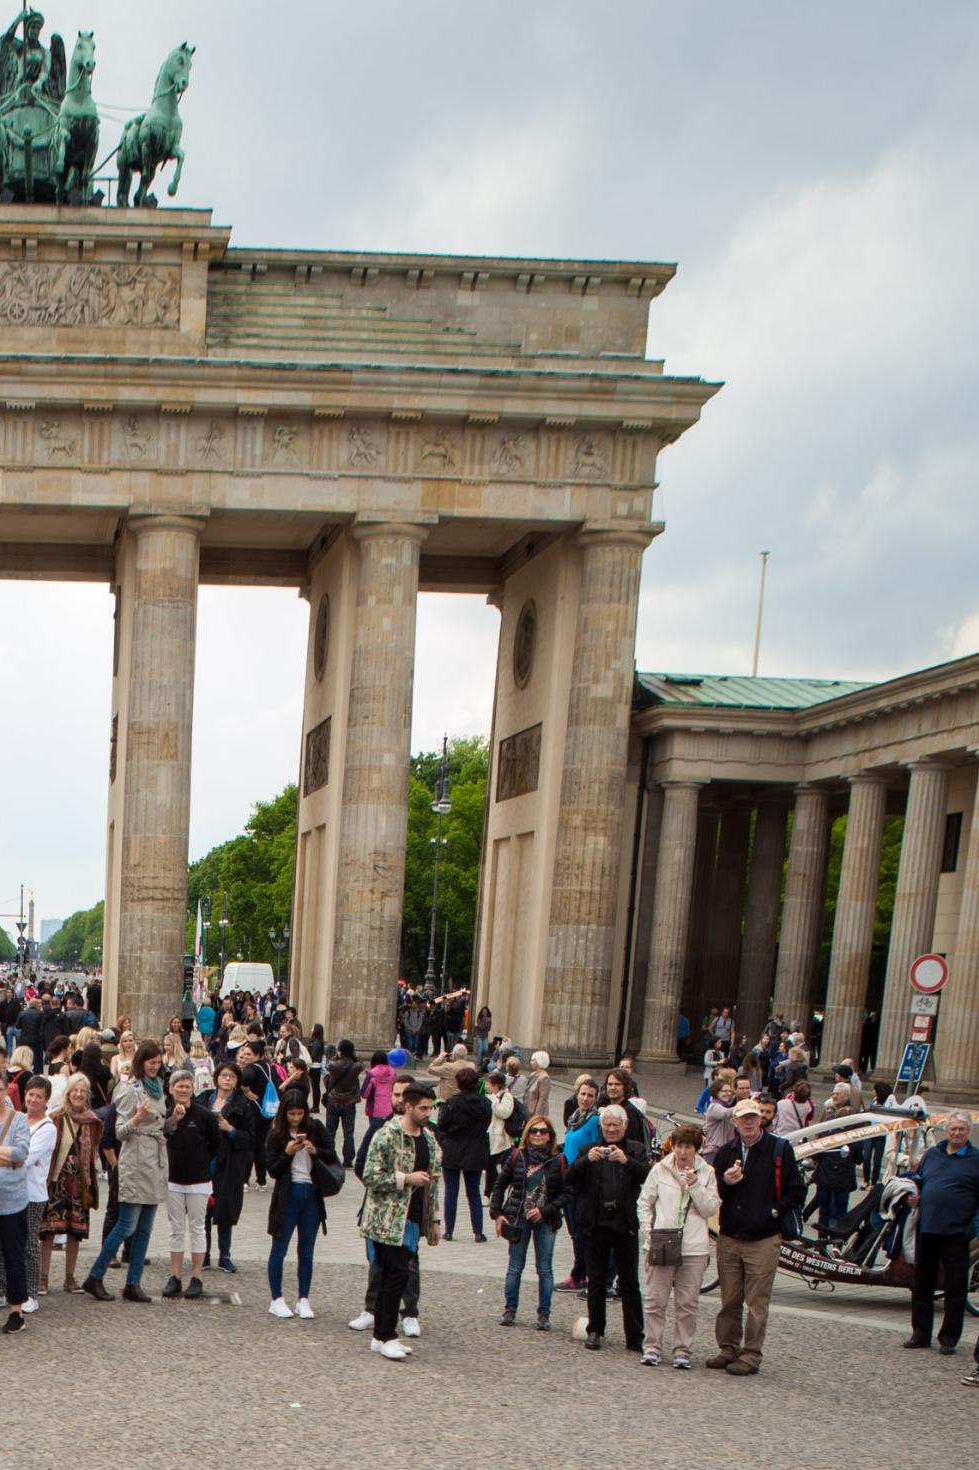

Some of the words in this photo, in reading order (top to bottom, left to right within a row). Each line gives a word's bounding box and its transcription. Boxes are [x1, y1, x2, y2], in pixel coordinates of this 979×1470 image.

[791, 1251, 806, 1262] DES
[806, 1256, 837, 1271] WESTENS
[838, 1265, 862, 1276] BERLIN
